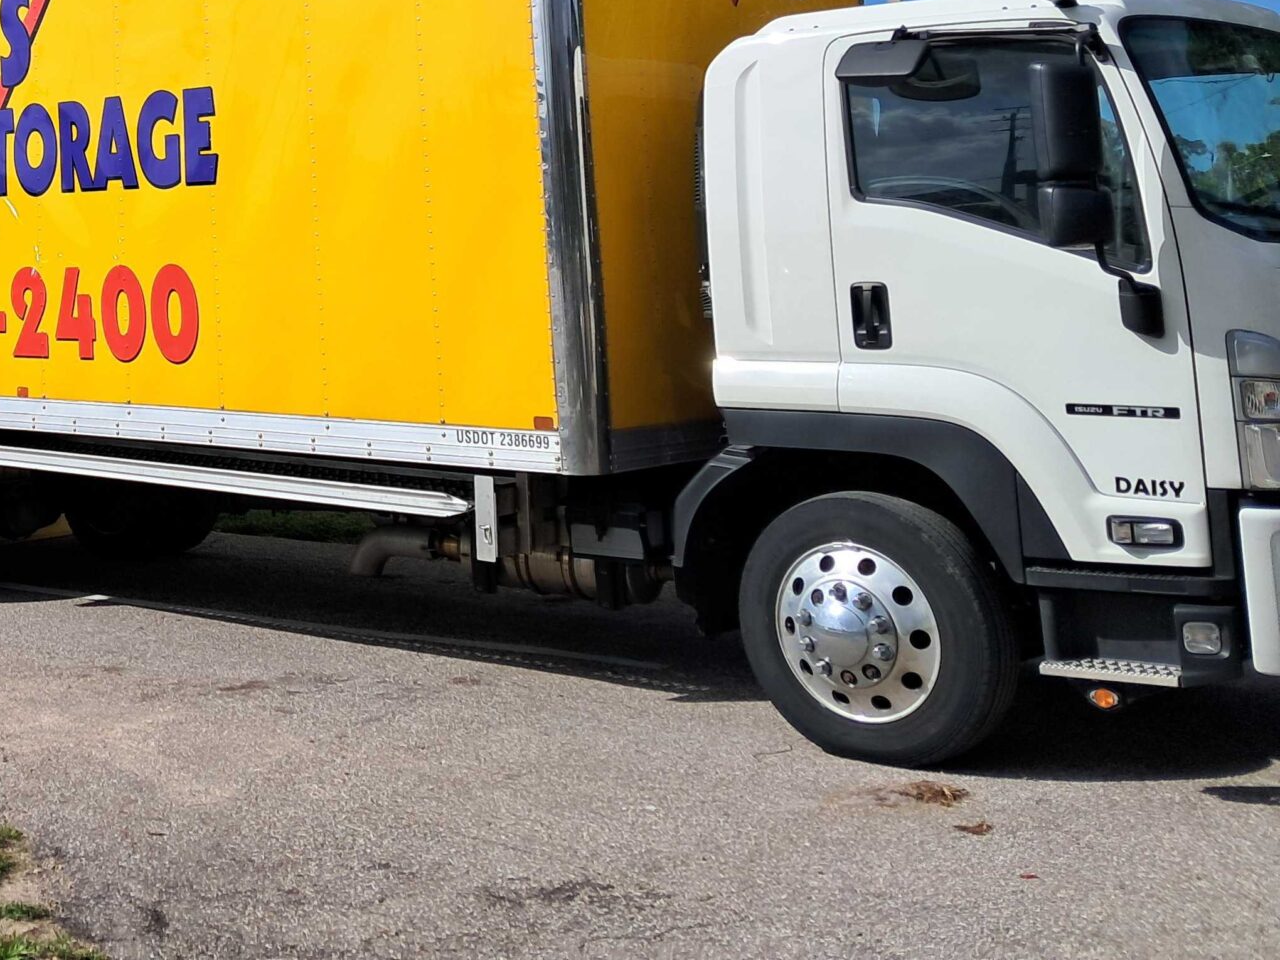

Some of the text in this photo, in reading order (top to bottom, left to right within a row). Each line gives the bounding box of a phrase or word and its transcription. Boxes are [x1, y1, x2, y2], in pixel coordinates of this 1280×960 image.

[1111, 406, 1166, 417] FTR
[456, 429, 550, 449] USDOT 2386699
[1115, 476, 1185, 498] DAISY
